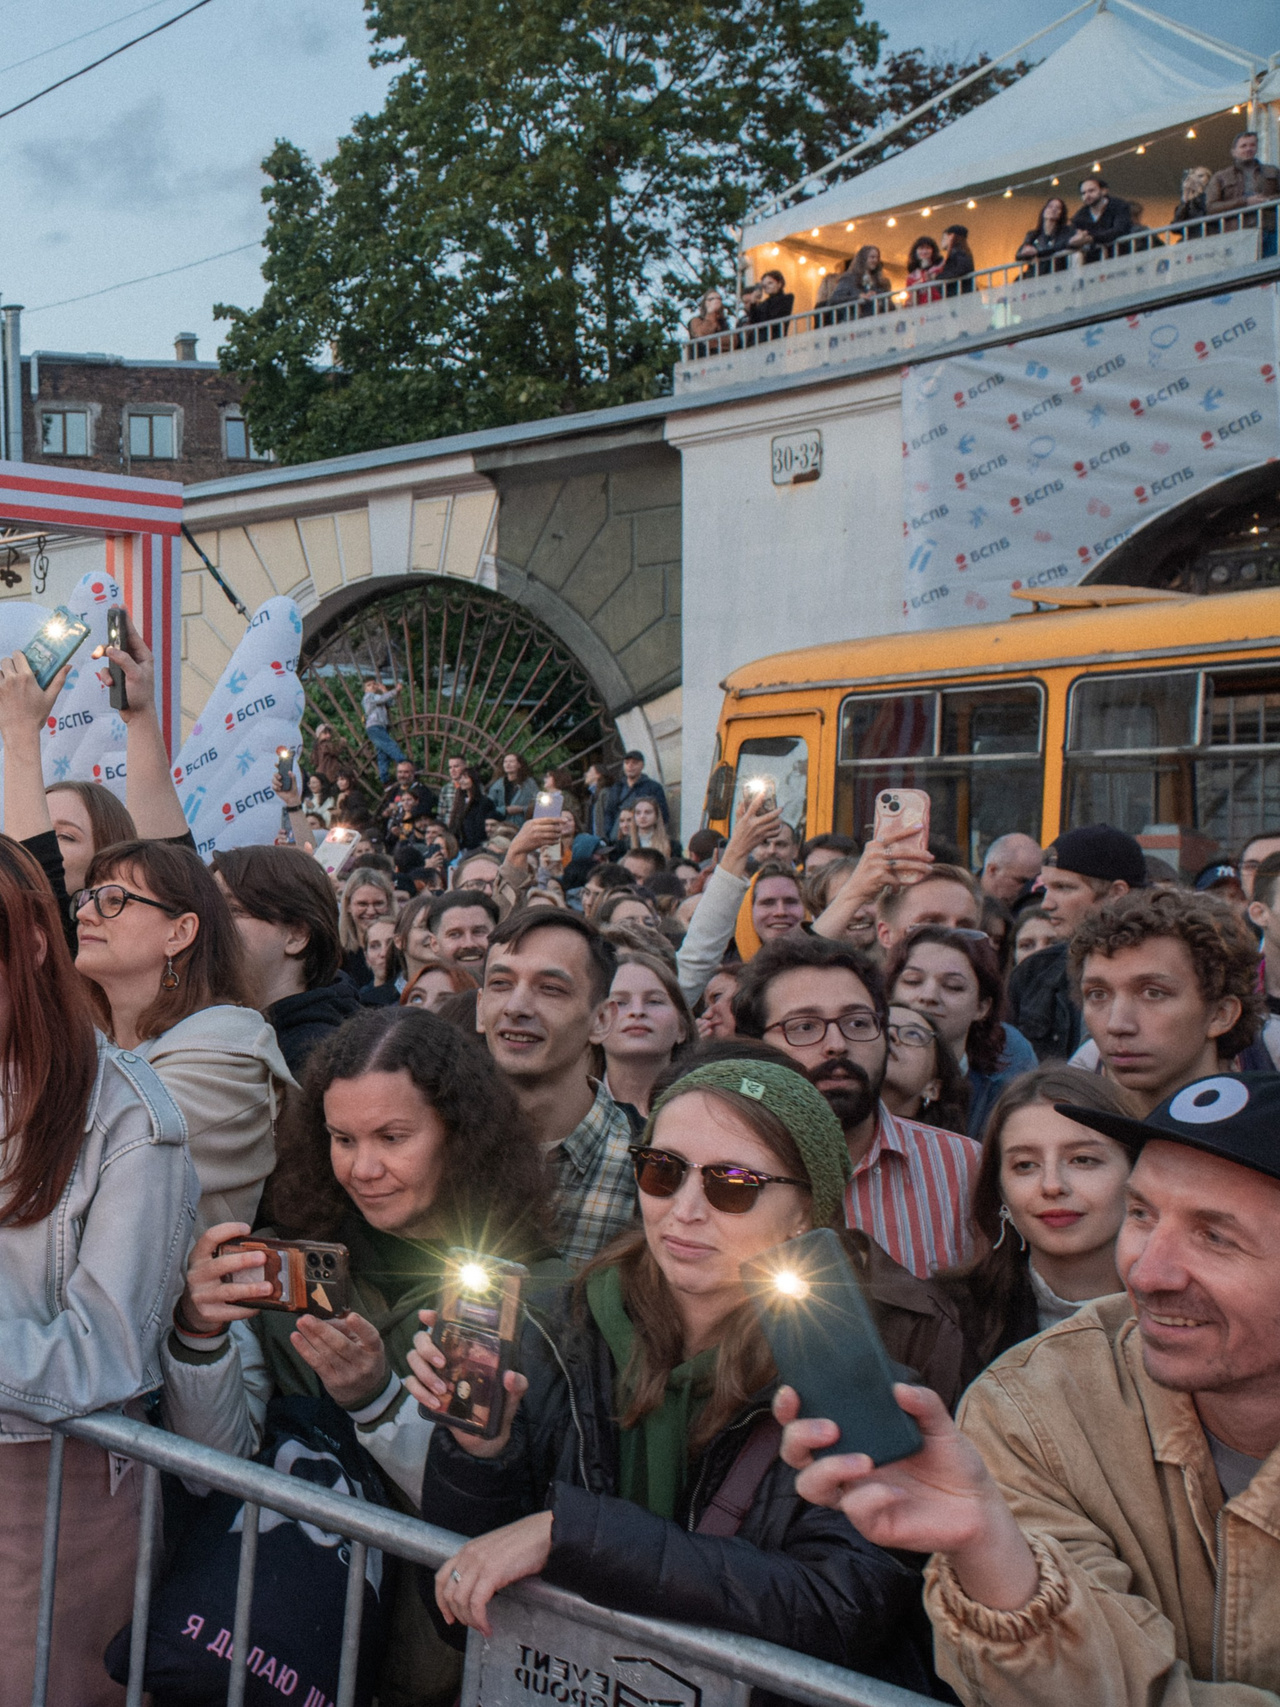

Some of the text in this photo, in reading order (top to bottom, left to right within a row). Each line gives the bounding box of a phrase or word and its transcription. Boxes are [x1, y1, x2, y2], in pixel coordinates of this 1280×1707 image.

[1210, 317, 1257, 349] БСПБ
[1086, 354, 1126, 384] БСПБ
[968, 372, 1005, 399] БСПБ
[1145, 376, 1190, 407] БСПБ
[1022, 393, 1063, 422] БСПБ
[911, 423, 948, 450] БСПБ
[1217, 410, 1263, 441] БСПБ
[968, 454, 1008, 481] БСПБ
[1088, 441, 1131, 471] БСПБ
[1024, 479, 1064, 506] БСПБ
[1150, 466, 1195, 496] БСПБ
[911, 504, 949, 530] БСПБ
[969, 537, 1010, 563] БСПБ
[911, 584, 950, 609] БСПБ
[58, 710, 94, 731] БСПБ
[236, 694, 276, 722] БСПБ
[185, 747, 218, 776] БСПБ
[235, 786, 275, 814] БСПБ
[180, 1614, 205, 1640] Я
